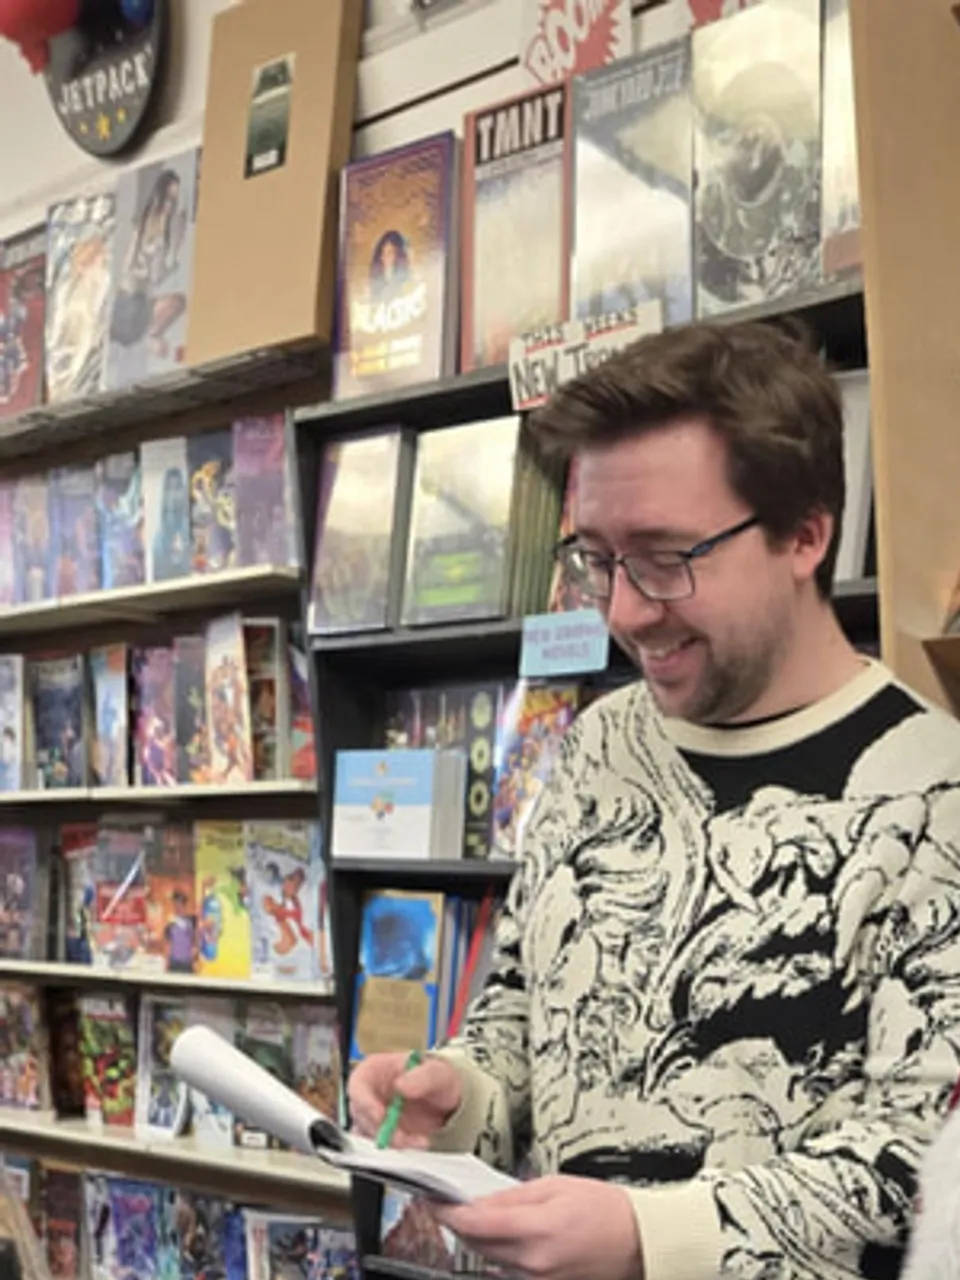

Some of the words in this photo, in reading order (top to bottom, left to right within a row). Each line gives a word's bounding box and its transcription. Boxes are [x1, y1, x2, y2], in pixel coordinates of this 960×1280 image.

[59, 51, 150, 114] JETPACK
[477, 91, 562, 162] TMNT
[511, 351, 558, 402] NEW
